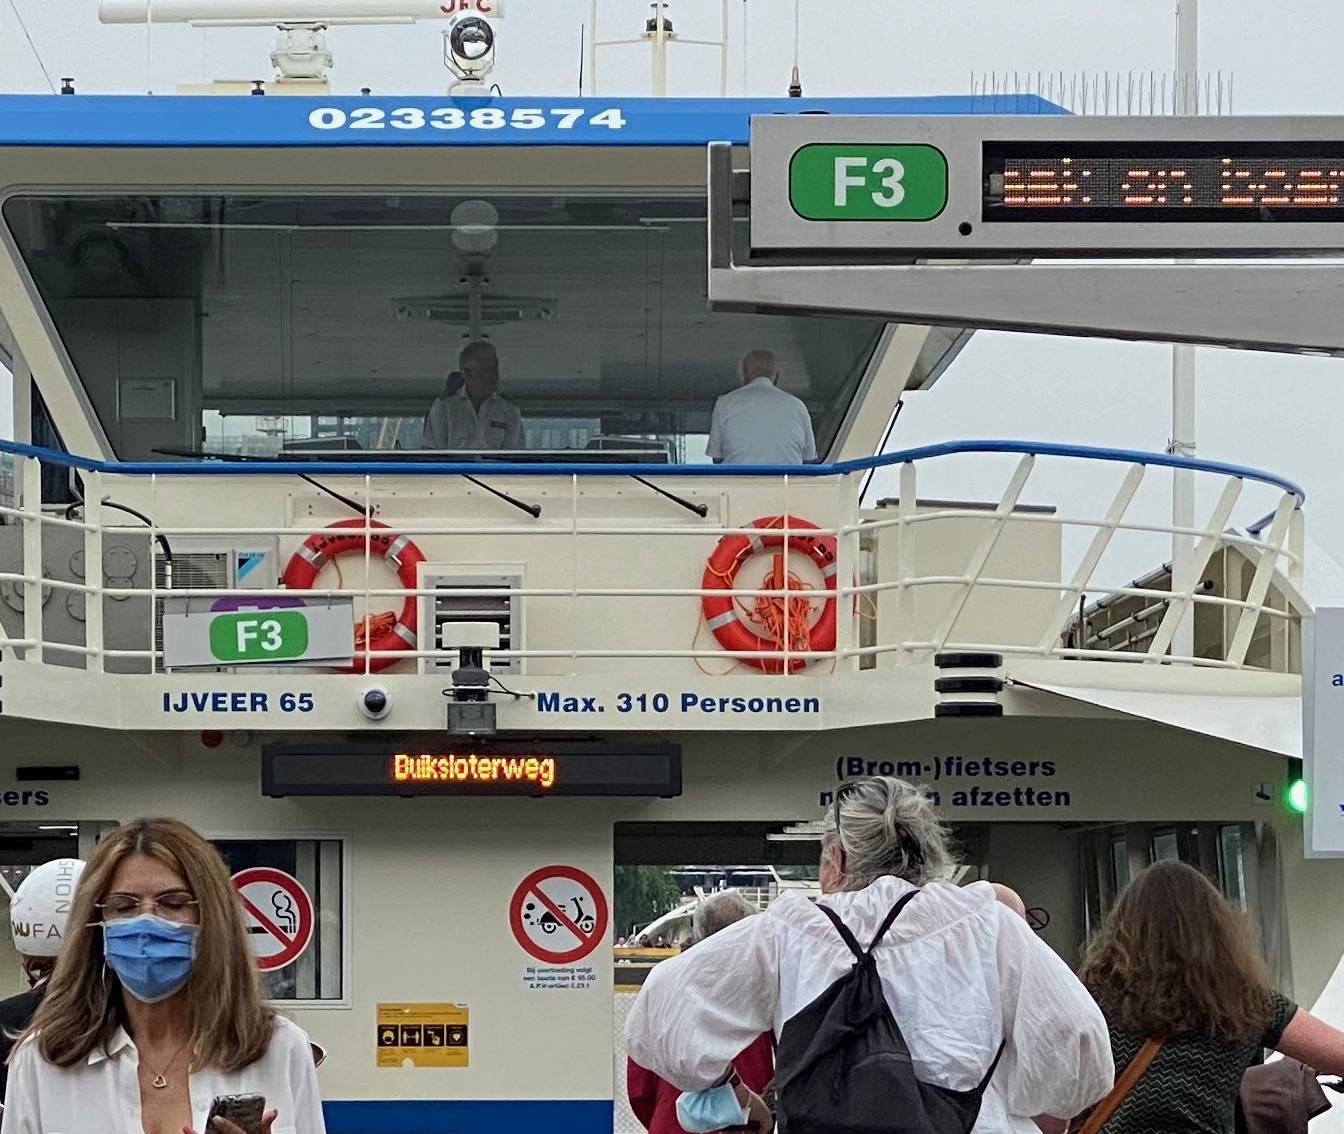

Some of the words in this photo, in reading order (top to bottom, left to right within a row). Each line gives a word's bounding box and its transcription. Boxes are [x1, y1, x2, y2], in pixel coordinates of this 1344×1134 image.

[308, 107, 626, 129] 02338574
[833, 156, 905, 208] F3
[1121, 170, 1192, 203] on
[236, 619, 283, 652] F3
[163, 692, 268, 712] IJVEER
[280, 692, 314, 713] 65
[537, 692, 604, 713] Max.
[616, 692, 669, 713] 310
[681, 692, 820, 713] Personen
[394, 754, 555, 787] Buiksloterweg
[836, 756, 1056, 781] (Brom-)fietsers
[952, 786, 1071, 806] afzetten
